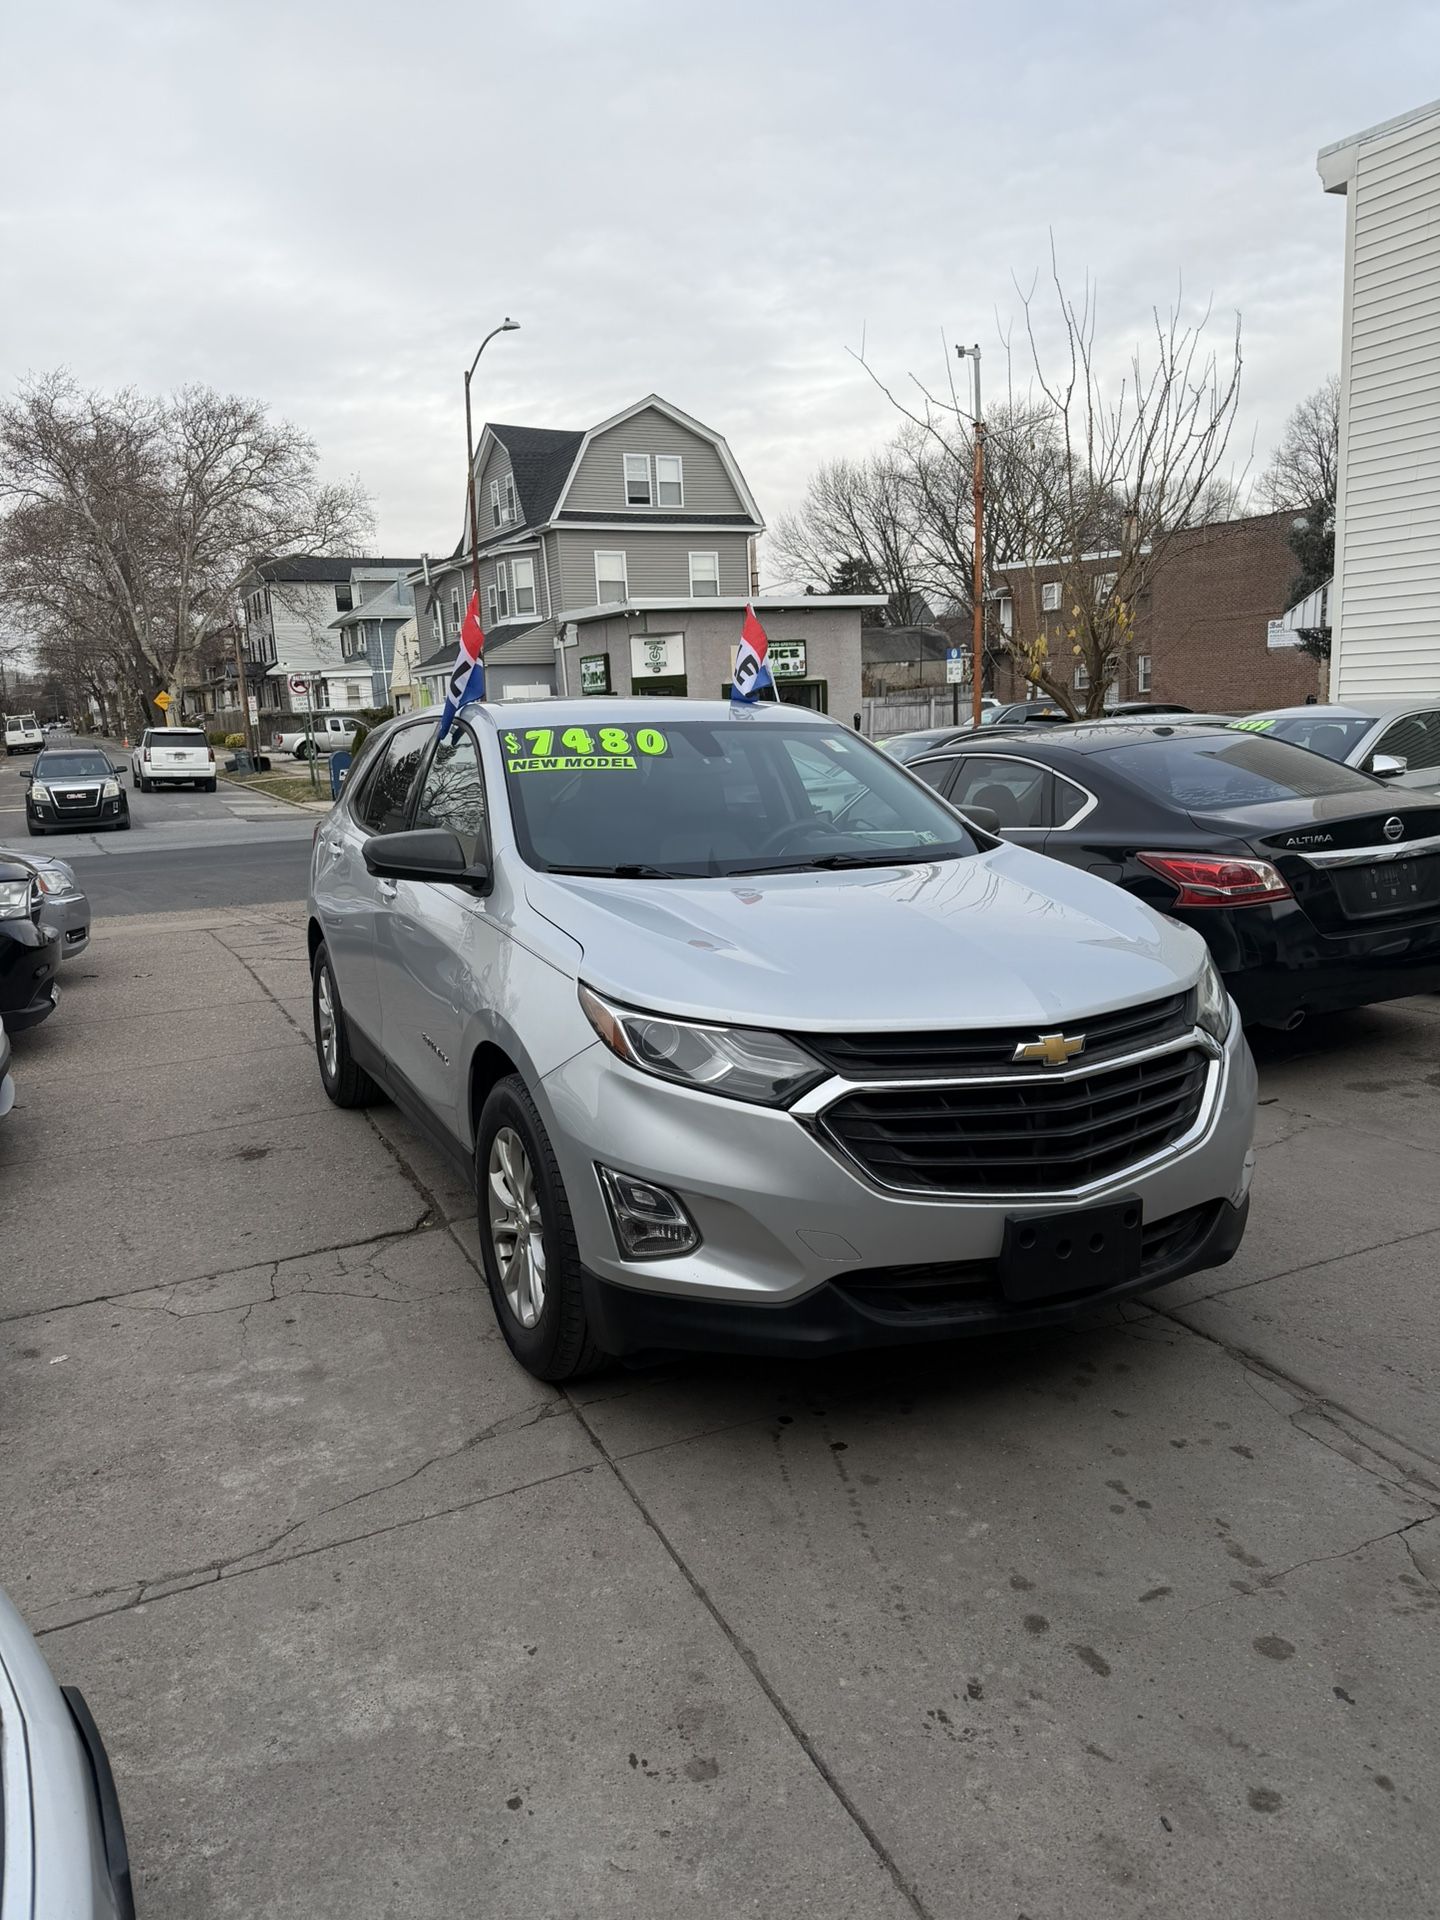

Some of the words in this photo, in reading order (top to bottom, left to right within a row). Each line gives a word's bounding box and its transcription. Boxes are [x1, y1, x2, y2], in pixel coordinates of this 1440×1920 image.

[504, 728, 668, 756] $7480
[512, 758, 560, 770] NEW
[564, 756, 634, 769] MODEL
[1286, 833, 1334, 847] ALTIMA
